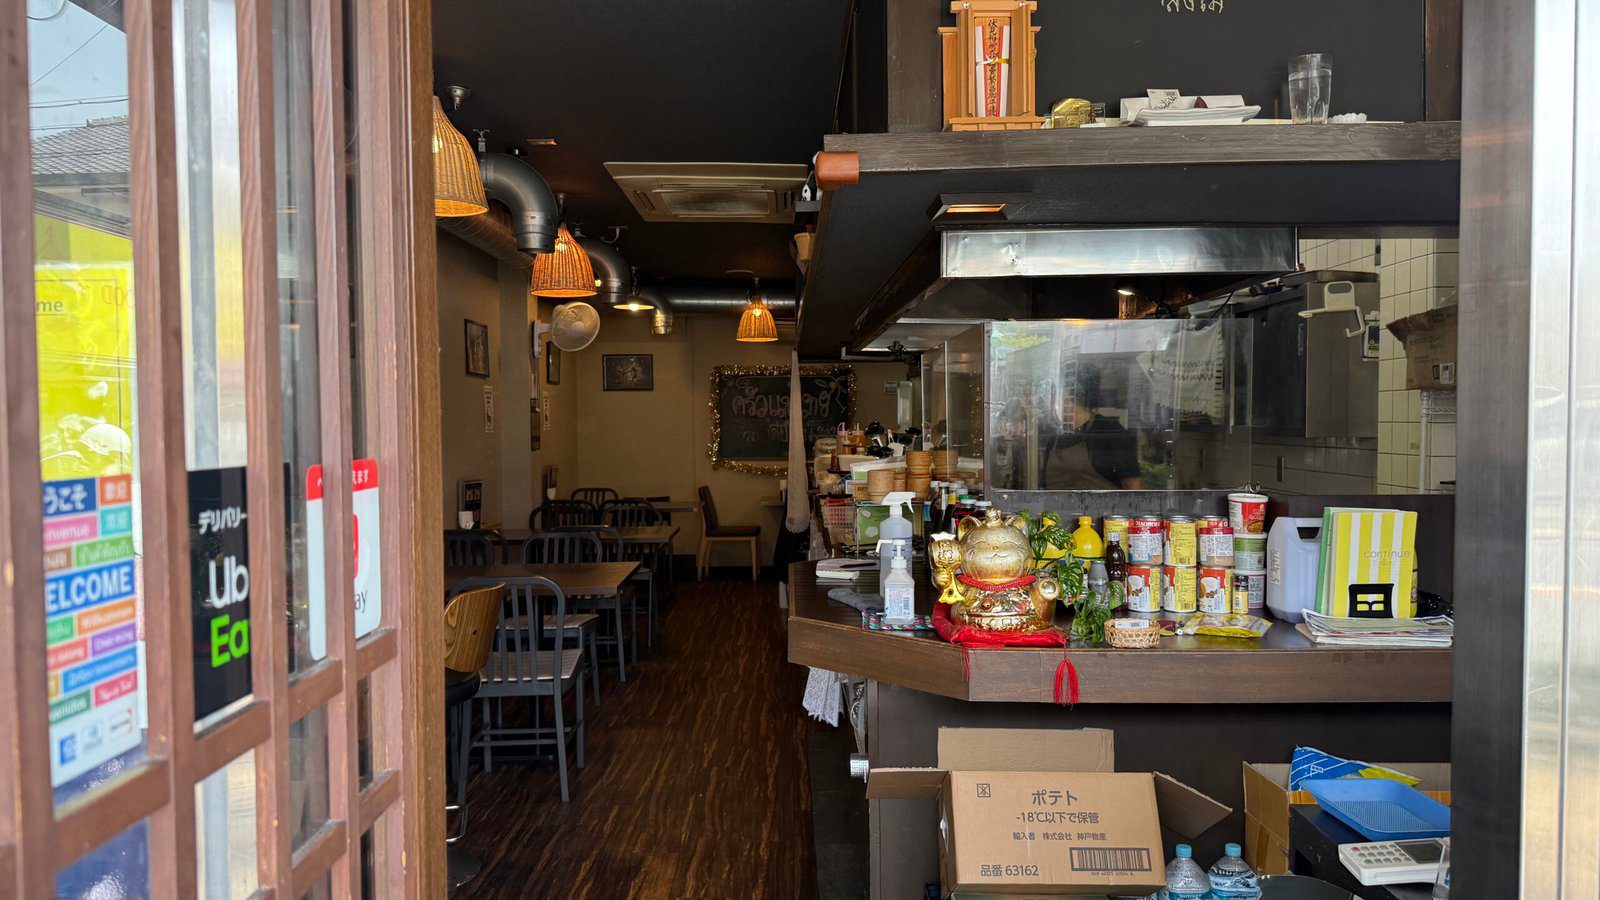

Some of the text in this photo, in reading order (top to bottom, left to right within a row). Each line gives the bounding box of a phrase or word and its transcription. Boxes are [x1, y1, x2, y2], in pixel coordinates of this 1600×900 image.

[43, 484, 88, 514] うこそ
[1363, 550, 1411, 559] continue
[47, 565, 133, 612] ELCOME
[209, 555, 249, 609] Ub
[353, 589, 368, 614] ay
[210, 614, 250, 668] Ea
[1031, 789, 1078, 806] ポテト
[1013, 832, 1107, 841] 輸入者 株式会社 神戸物産
[980, 864, 1039, 877] 品番 63162
